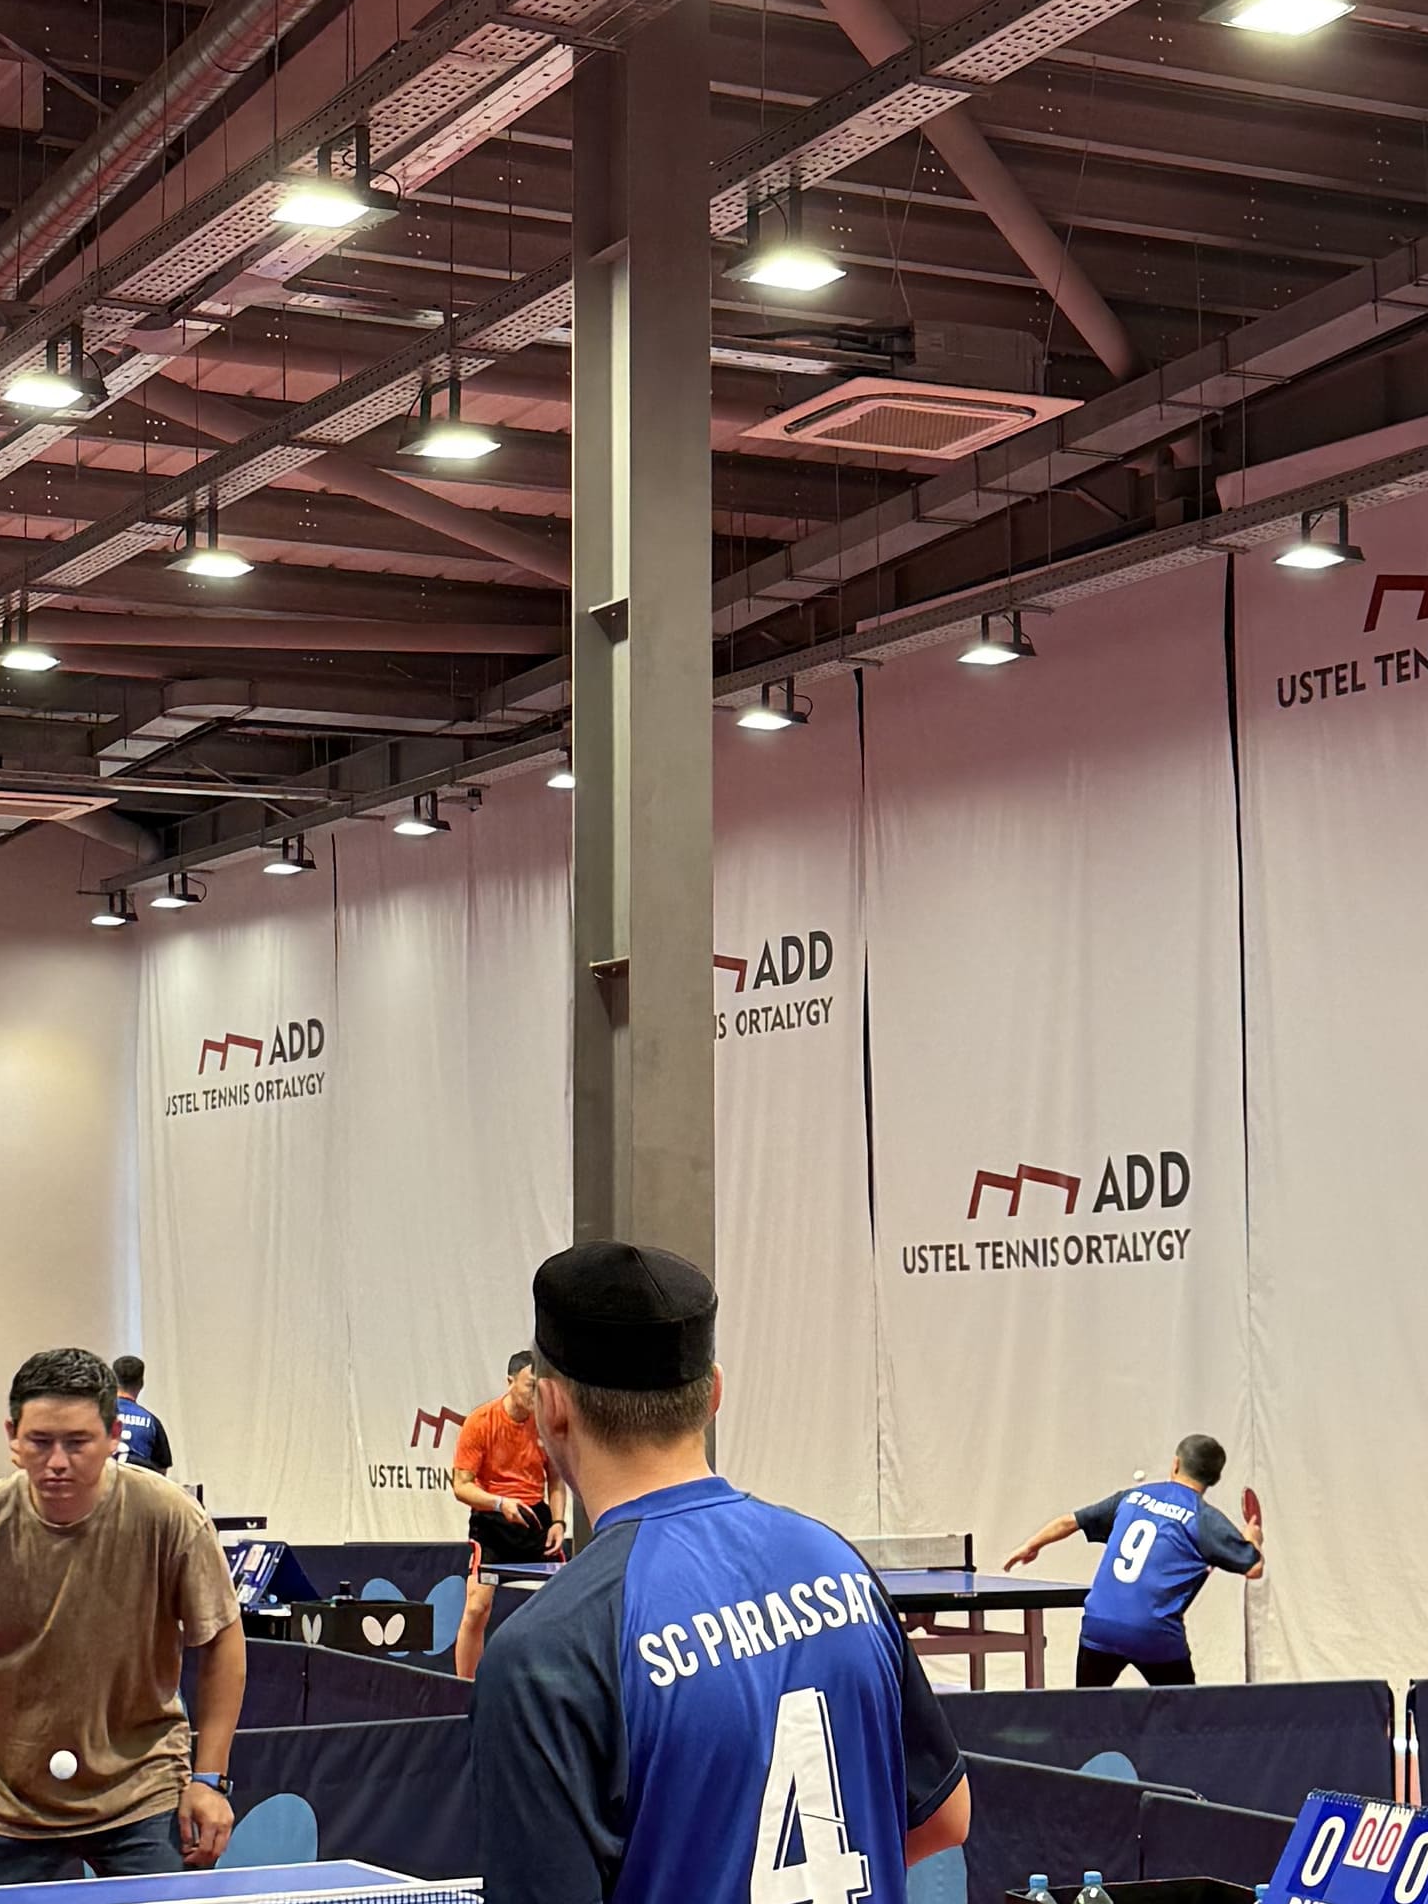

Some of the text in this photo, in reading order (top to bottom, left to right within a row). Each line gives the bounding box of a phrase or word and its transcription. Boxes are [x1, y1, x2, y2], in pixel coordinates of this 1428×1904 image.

[1277, 660, 1367, 708] USTEL
[752, 930, 834, 990] ADD
[735, 996, 834, 1037] ORTALYGY
[268, 1018, 325, 1065] ADD
[202, 1083, 250, 1110] TENNIS
[254, 1071, 326, 1103] ORTALYGY
[1092, 1151, 1191, 1213] ADD
[902, 1228, 1191, 1274] USTEL TENNIS ORTALYGY
[368, 1464, 456, 1491] USTEL TENN
[1113, 1519, 1158, 1584] 9
[638, 1572, 879, 1688] SC PARASSAT
[1300, 1815, 1346, 1887] 0
[1352, 1817, 1377, 1861] 0
[1376, 1822, 1403, 1866] 0
